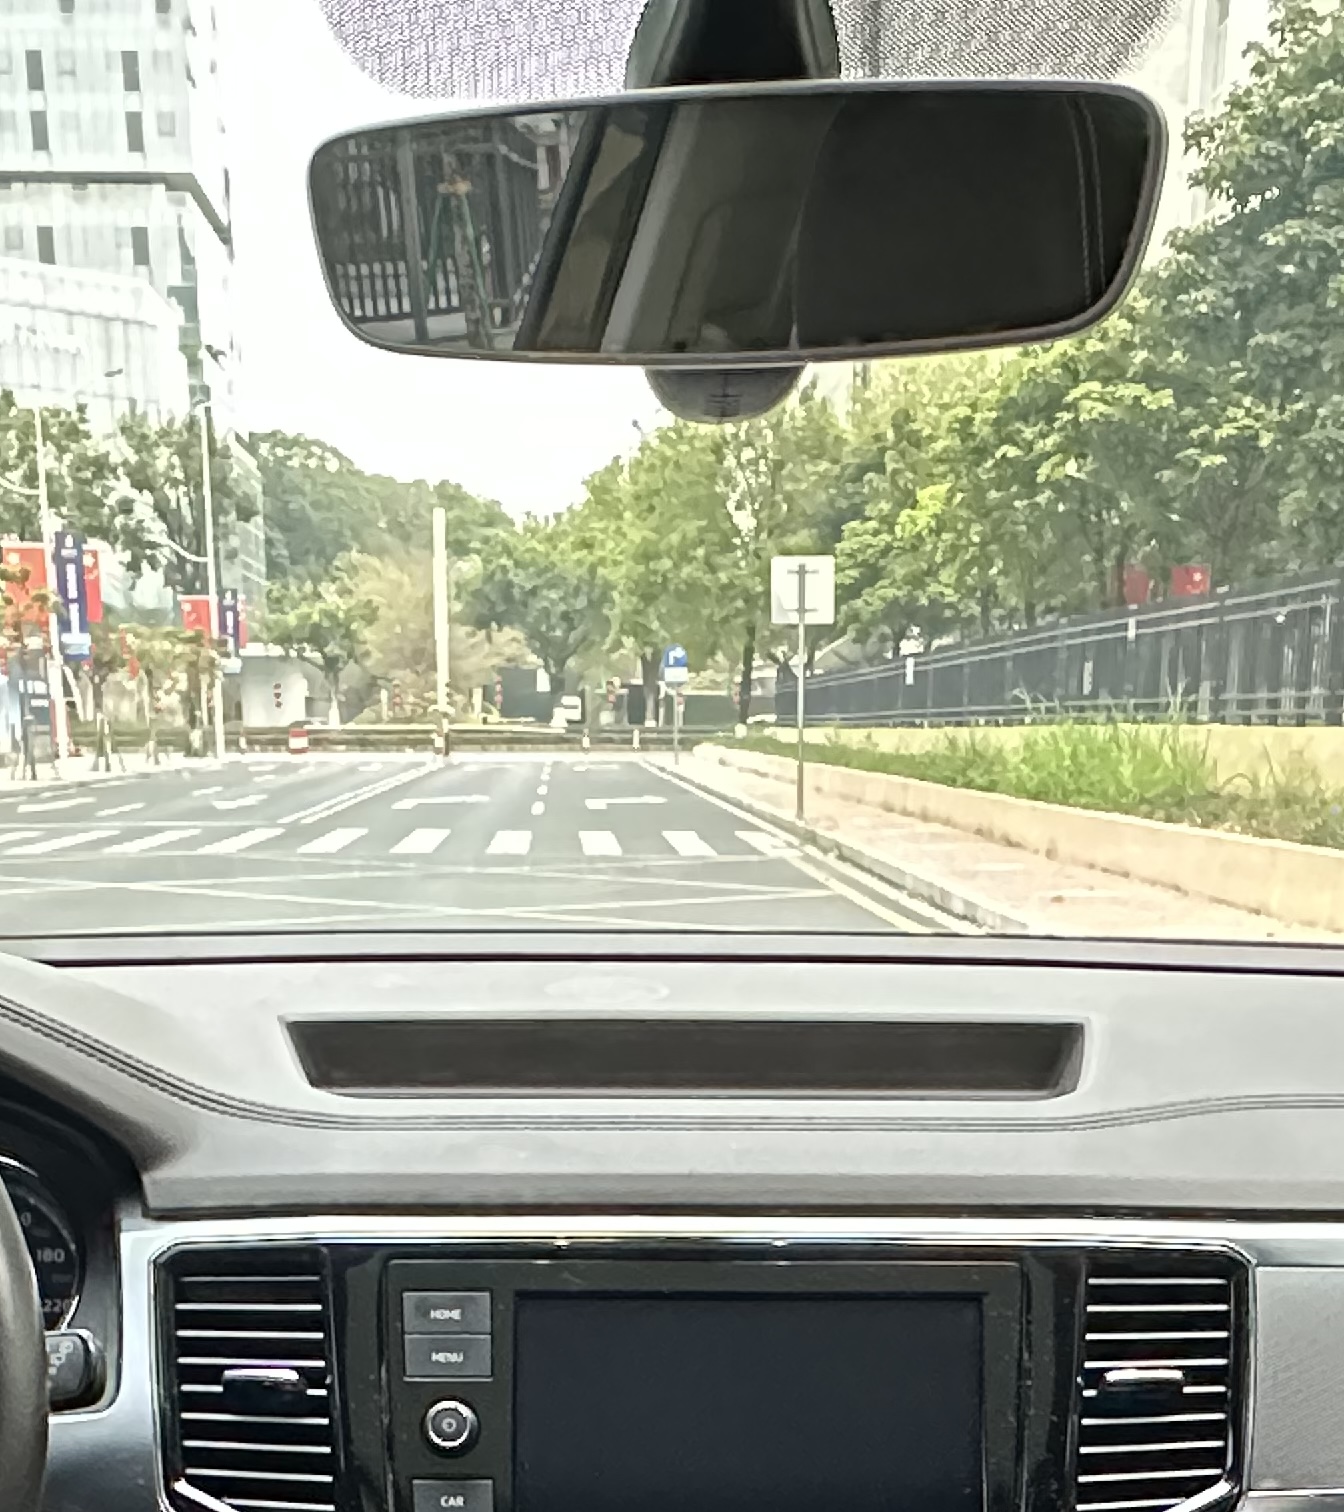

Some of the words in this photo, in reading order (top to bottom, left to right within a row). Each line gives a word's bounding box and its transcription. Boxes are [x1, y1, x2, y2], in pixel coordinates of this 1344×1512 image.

[36, 1249, 65, 1263] 180
[430, 1308, 462, 1320] HOME
[431, 1351, 464, 1363] MENU
[440, 1495, 464, 1507] CAR
